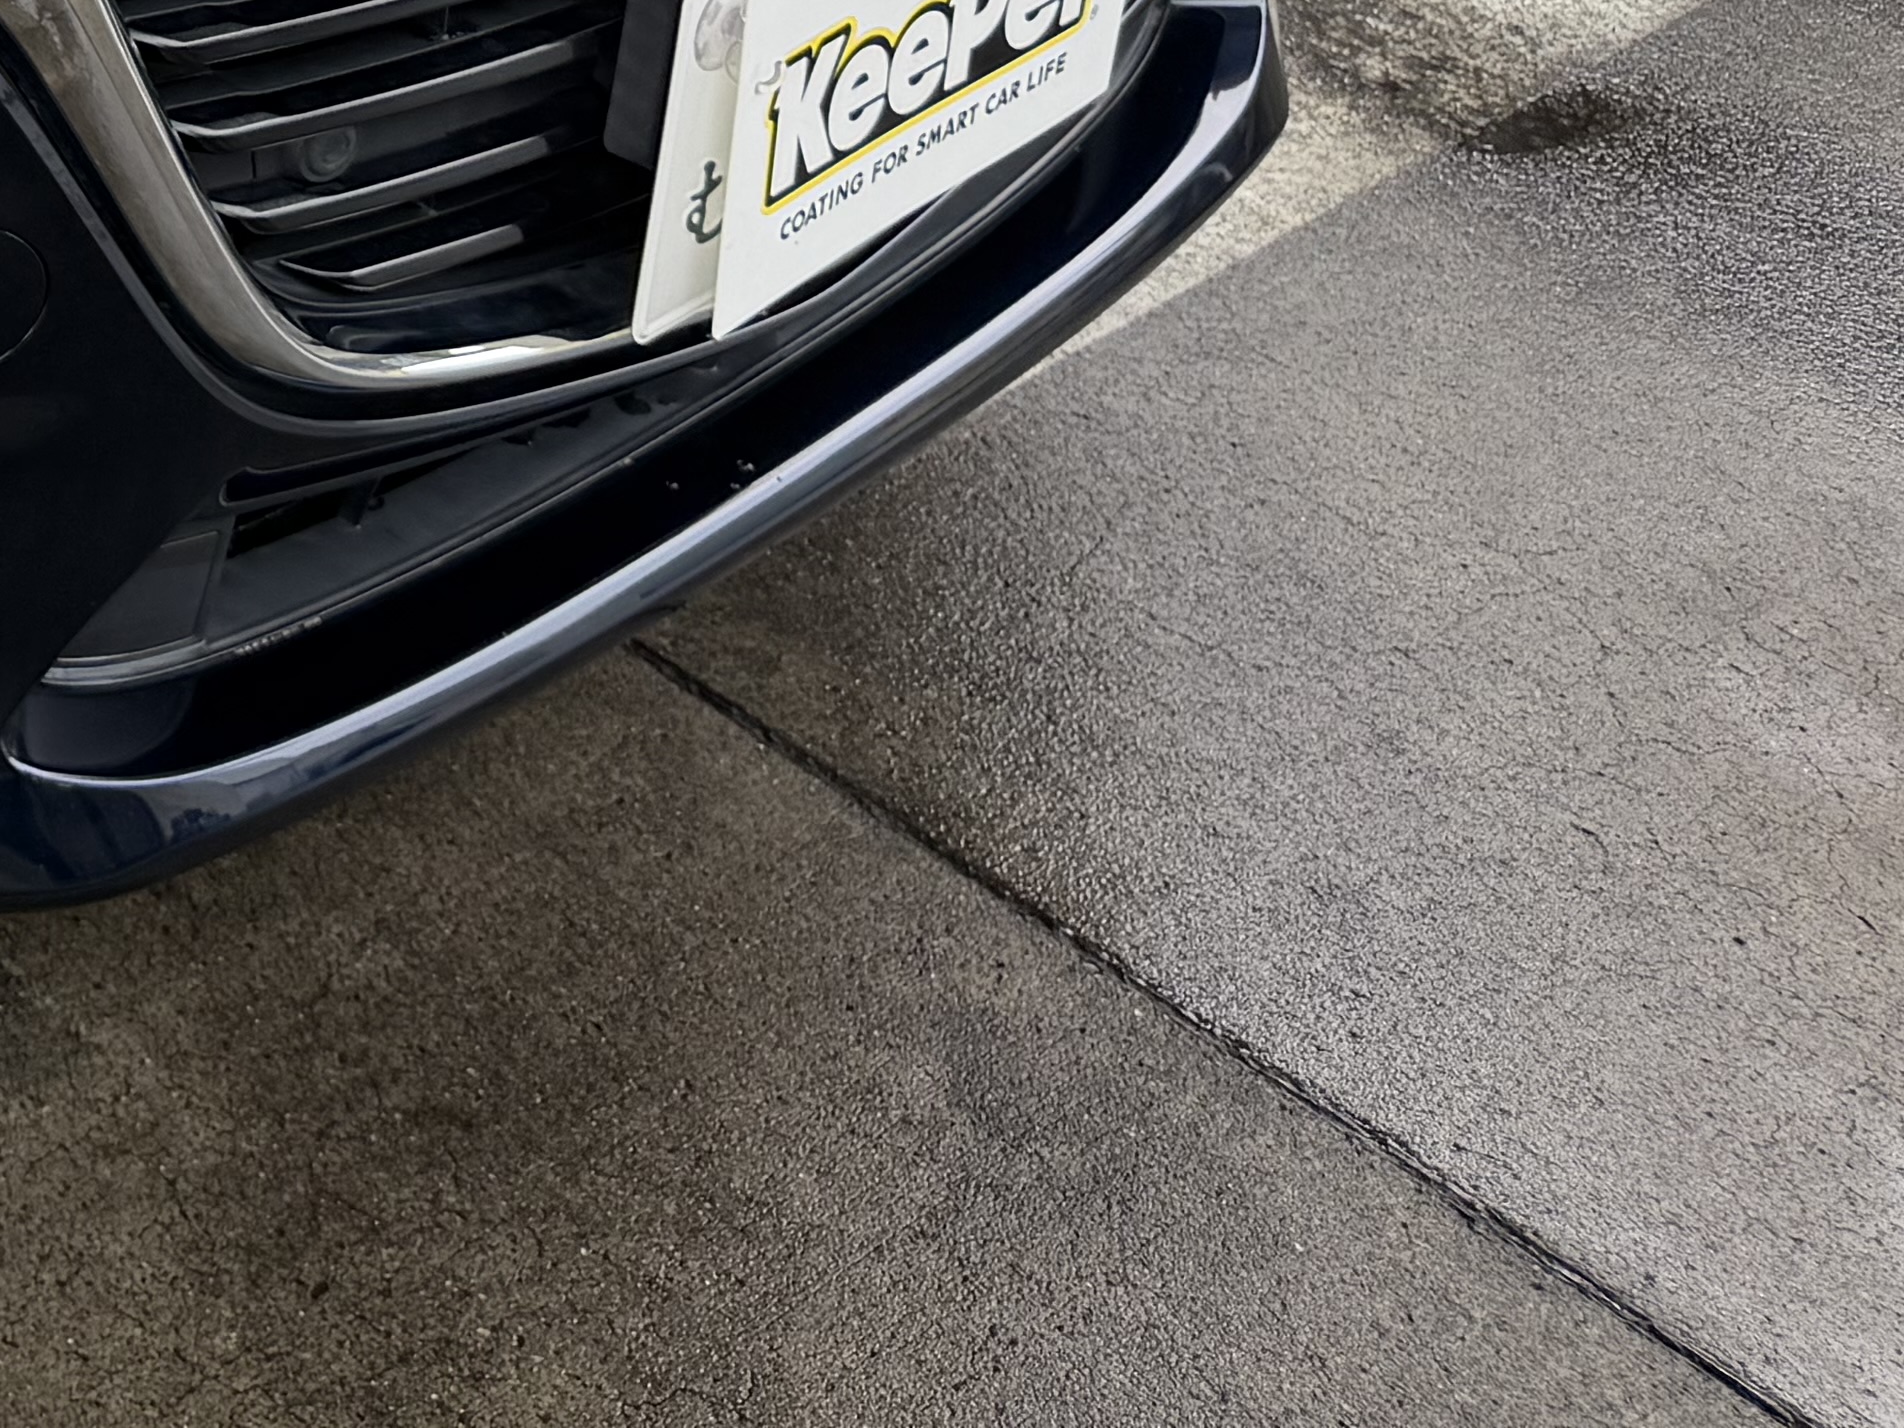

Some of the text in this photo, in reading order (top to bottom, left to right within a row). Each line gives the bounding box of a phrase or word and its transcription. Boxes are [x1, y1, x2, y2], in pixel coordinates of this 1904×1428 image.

[779, 51, 1068, 241] COATING FOR SMART CAR LIFE
